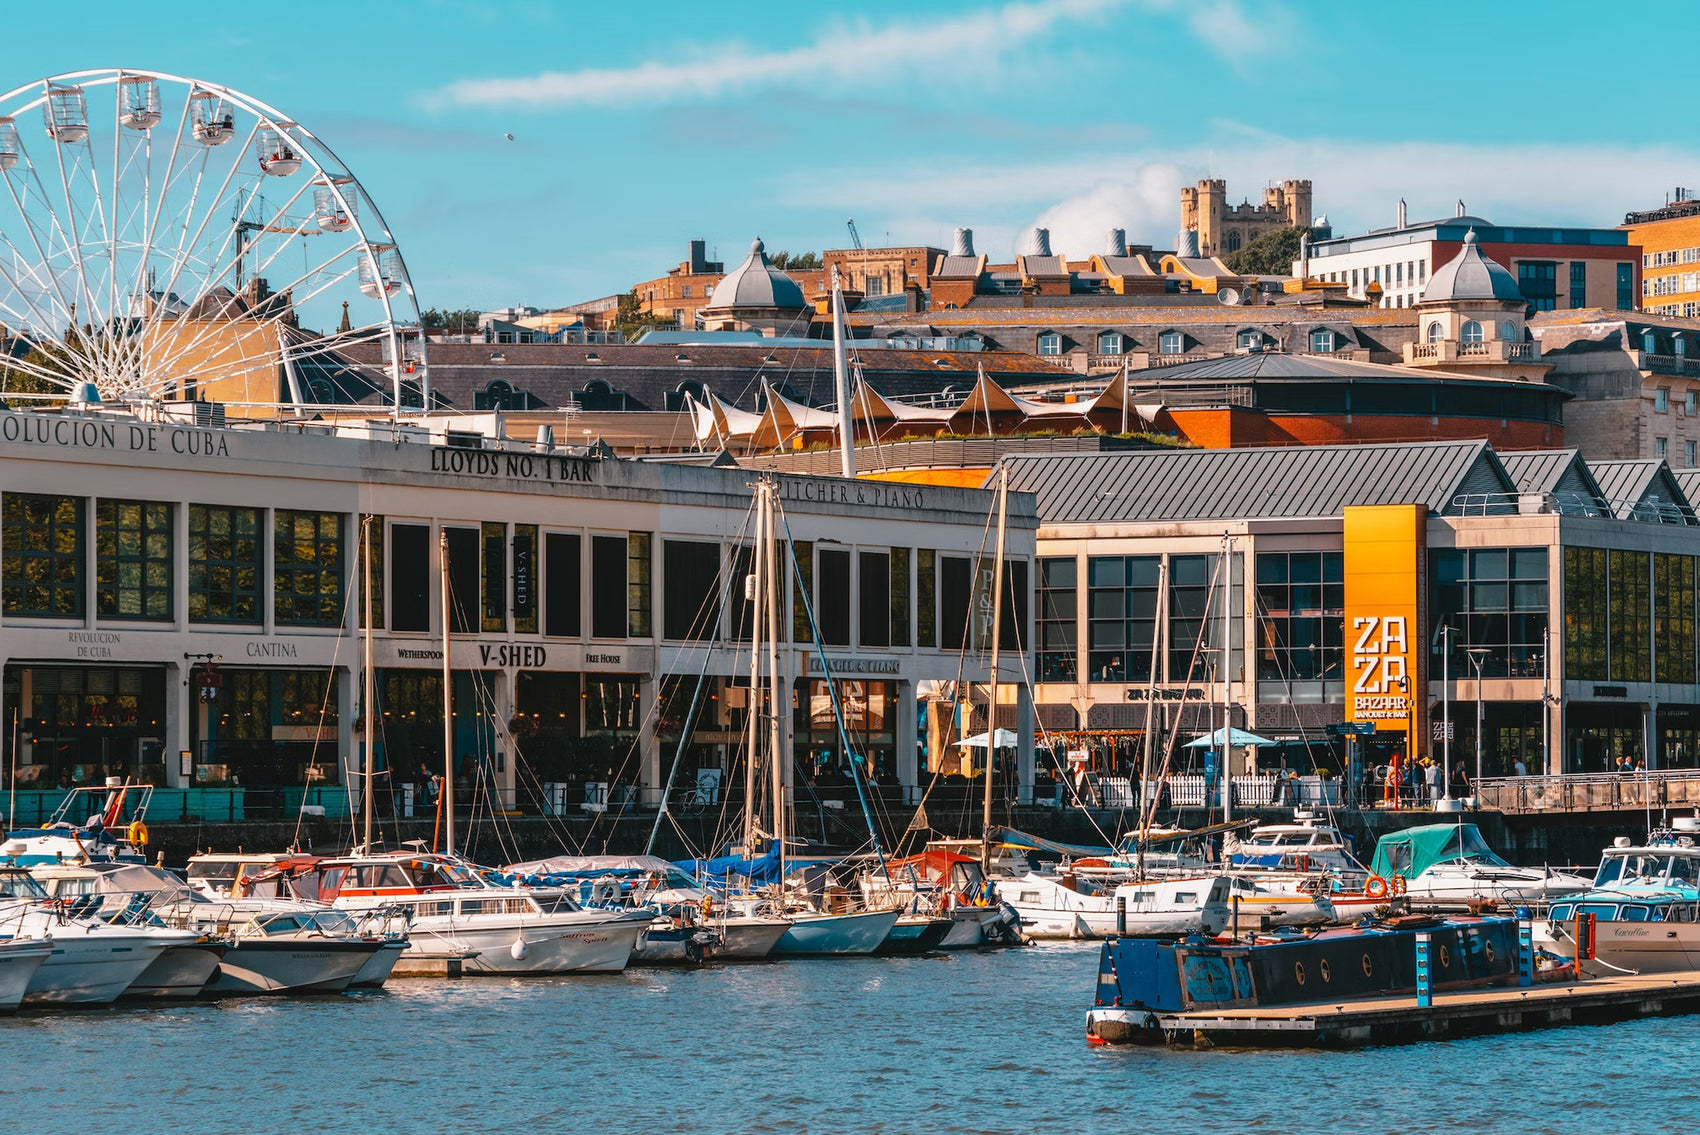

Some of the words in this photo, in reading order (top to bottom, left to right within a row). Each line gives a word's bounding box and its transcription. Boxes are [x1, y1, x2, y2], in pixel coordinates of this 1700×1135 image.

[3, 415, 115, 449] OLUCION
[129, 425, 156, 451] DE
[171, 429, 230, 457] CUBA
[431, 450, 499, 476] LLOYDS
[506, 455, 538, 478] NO.
[545, 459, 552, 479] 1
[560, 460, 593, 482] BAR
[856, 487, 866, 504] &
[875, 488, 923, 509] PIANO
[517, 551, 527, 604] V-SHED
[68, 632, 121, 644] REVOLUCION
[1353, 616, 1408, 654] ZA
[77, 646, 89, 657] DE
[90, 647, 112, 657] CUBA
[246, 642, 298, 658] CANTINA
[479, 645, 546, 667] V-SHED
[1353, 656, 1408, 693] ZA
[1353, 697, 1408, 709] BAZAAR
[1354, 710, 1386, 719] BANQUET
[581, 936, 608, 945] Spirit
